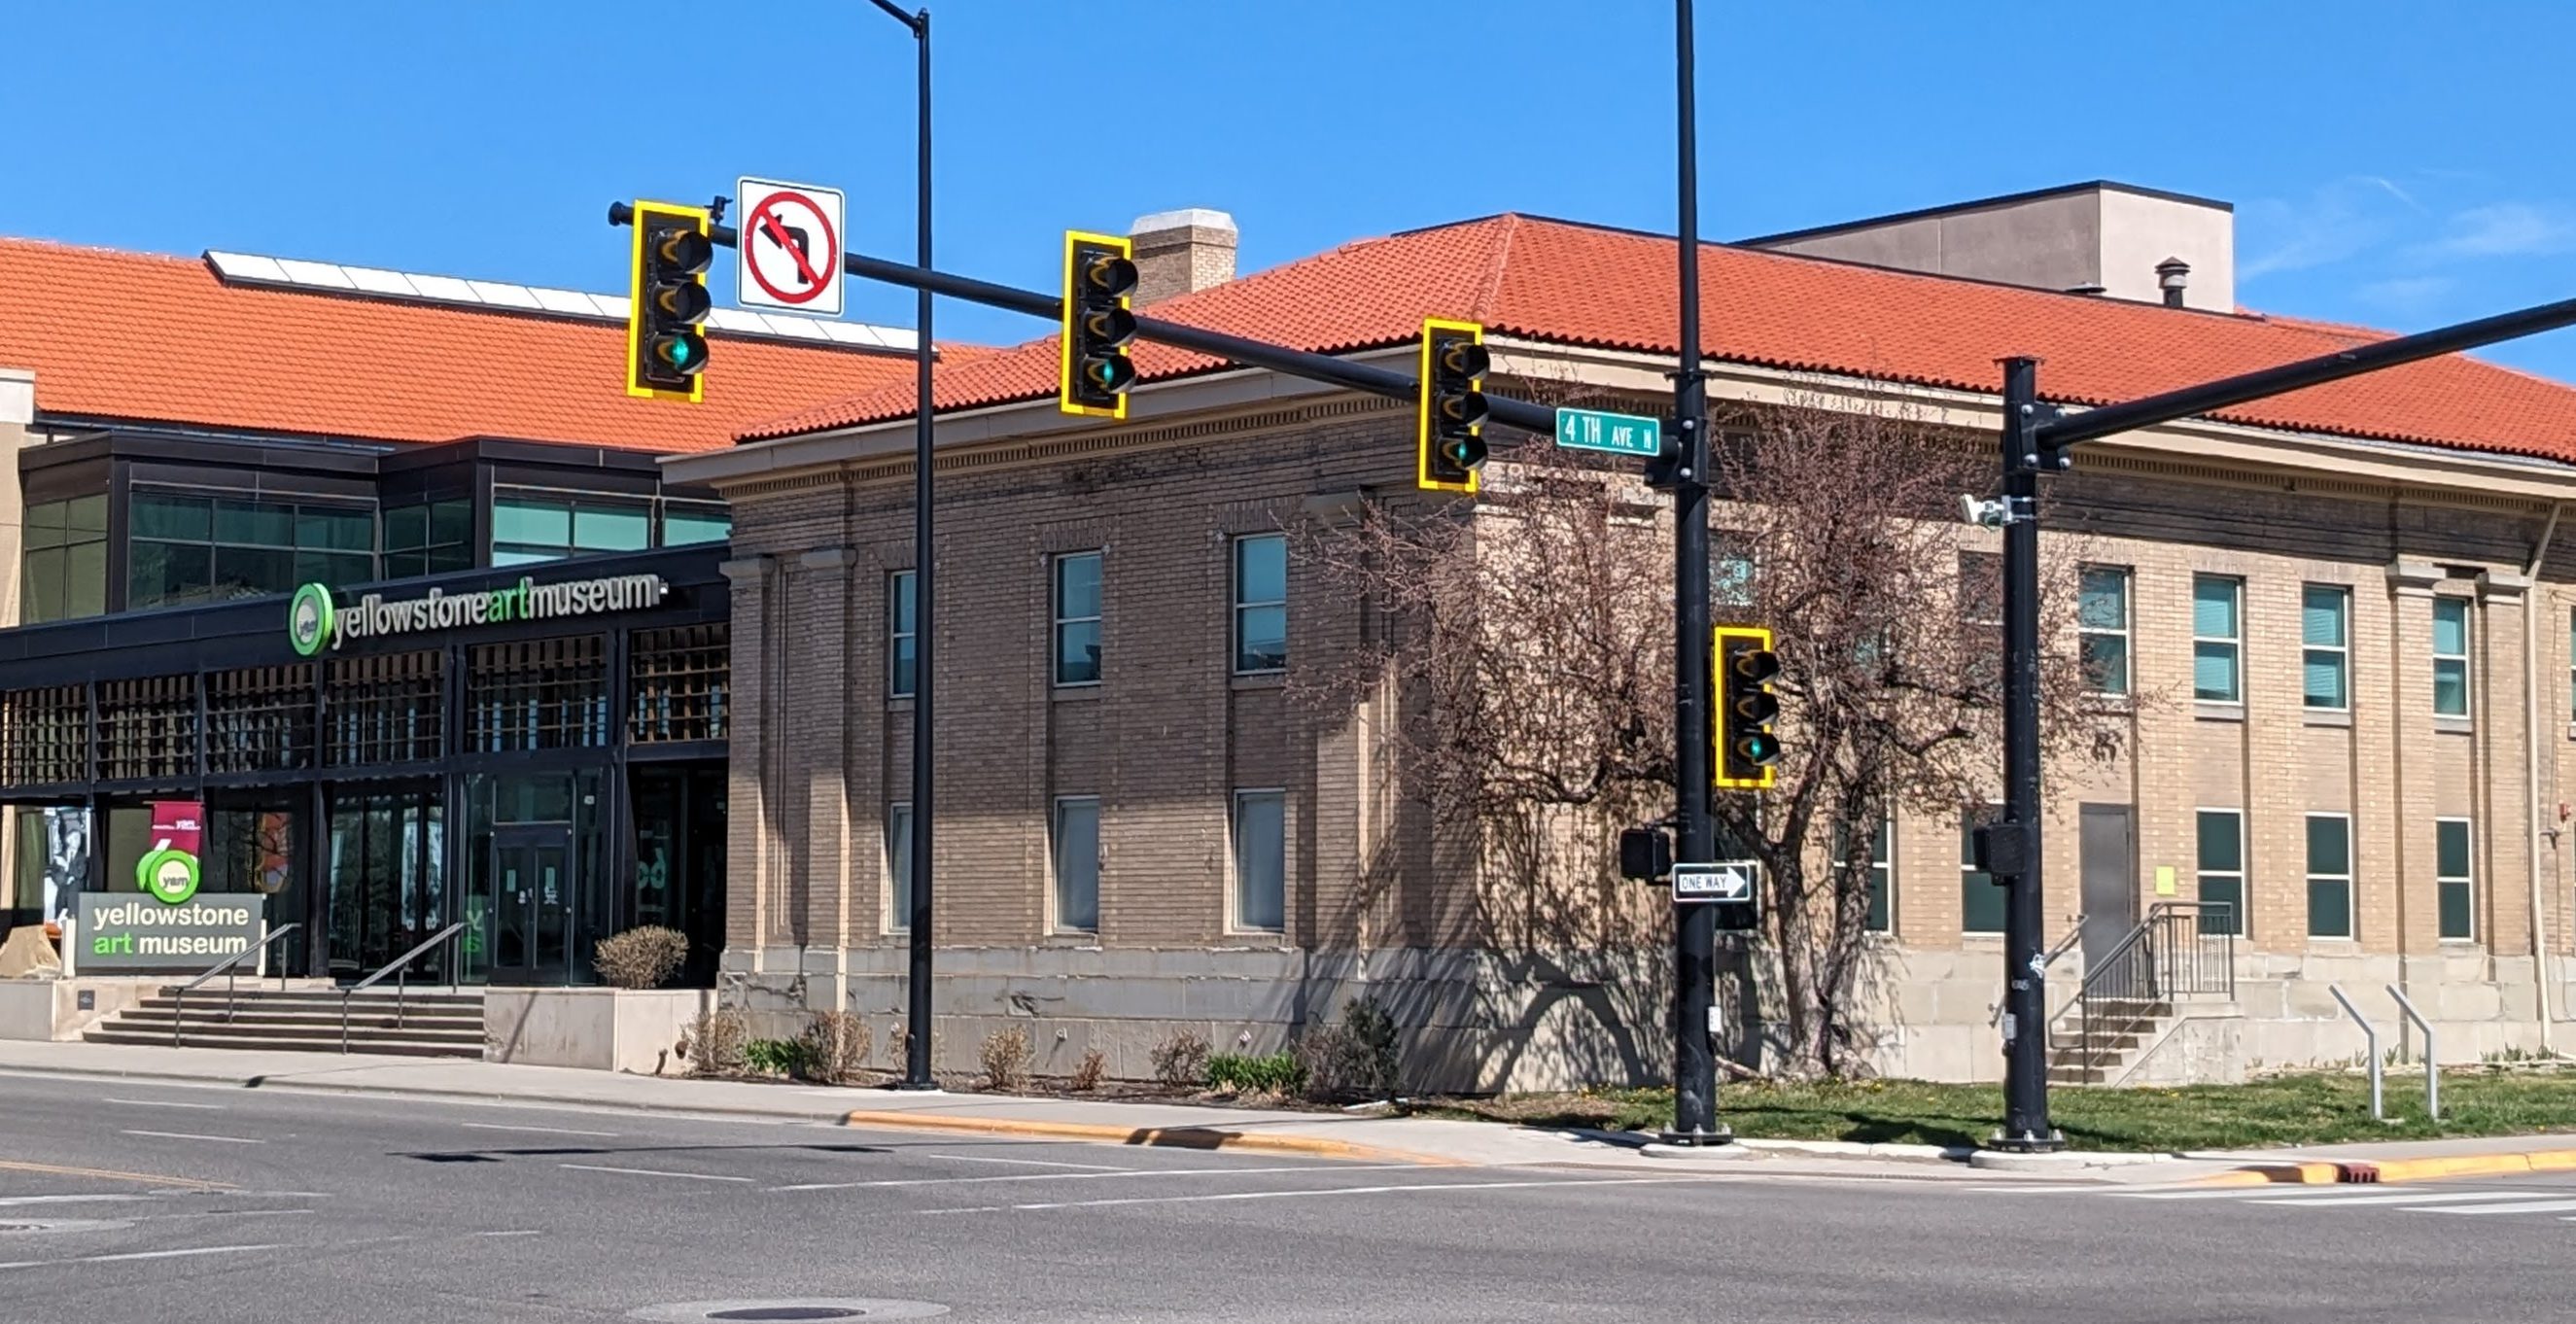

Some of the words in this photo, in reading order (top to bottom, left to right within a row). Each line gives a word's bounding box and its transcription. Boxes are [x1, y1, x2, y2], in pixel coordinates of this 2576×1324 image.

[1565, 414, 1576, 441] 4
[1582, 416, 1601, 444] TH
[1611, 426, 1634, 447] AVE
[1643, 429, 1652, 449] N
[1682, 876, 1702, 889] ONE
[1704, 876, 1727, 888] WAY
[93, 902, 249, 930] yellowstone
[93, 932, 133, 955] art
[139, 935, 248, 955] museum
